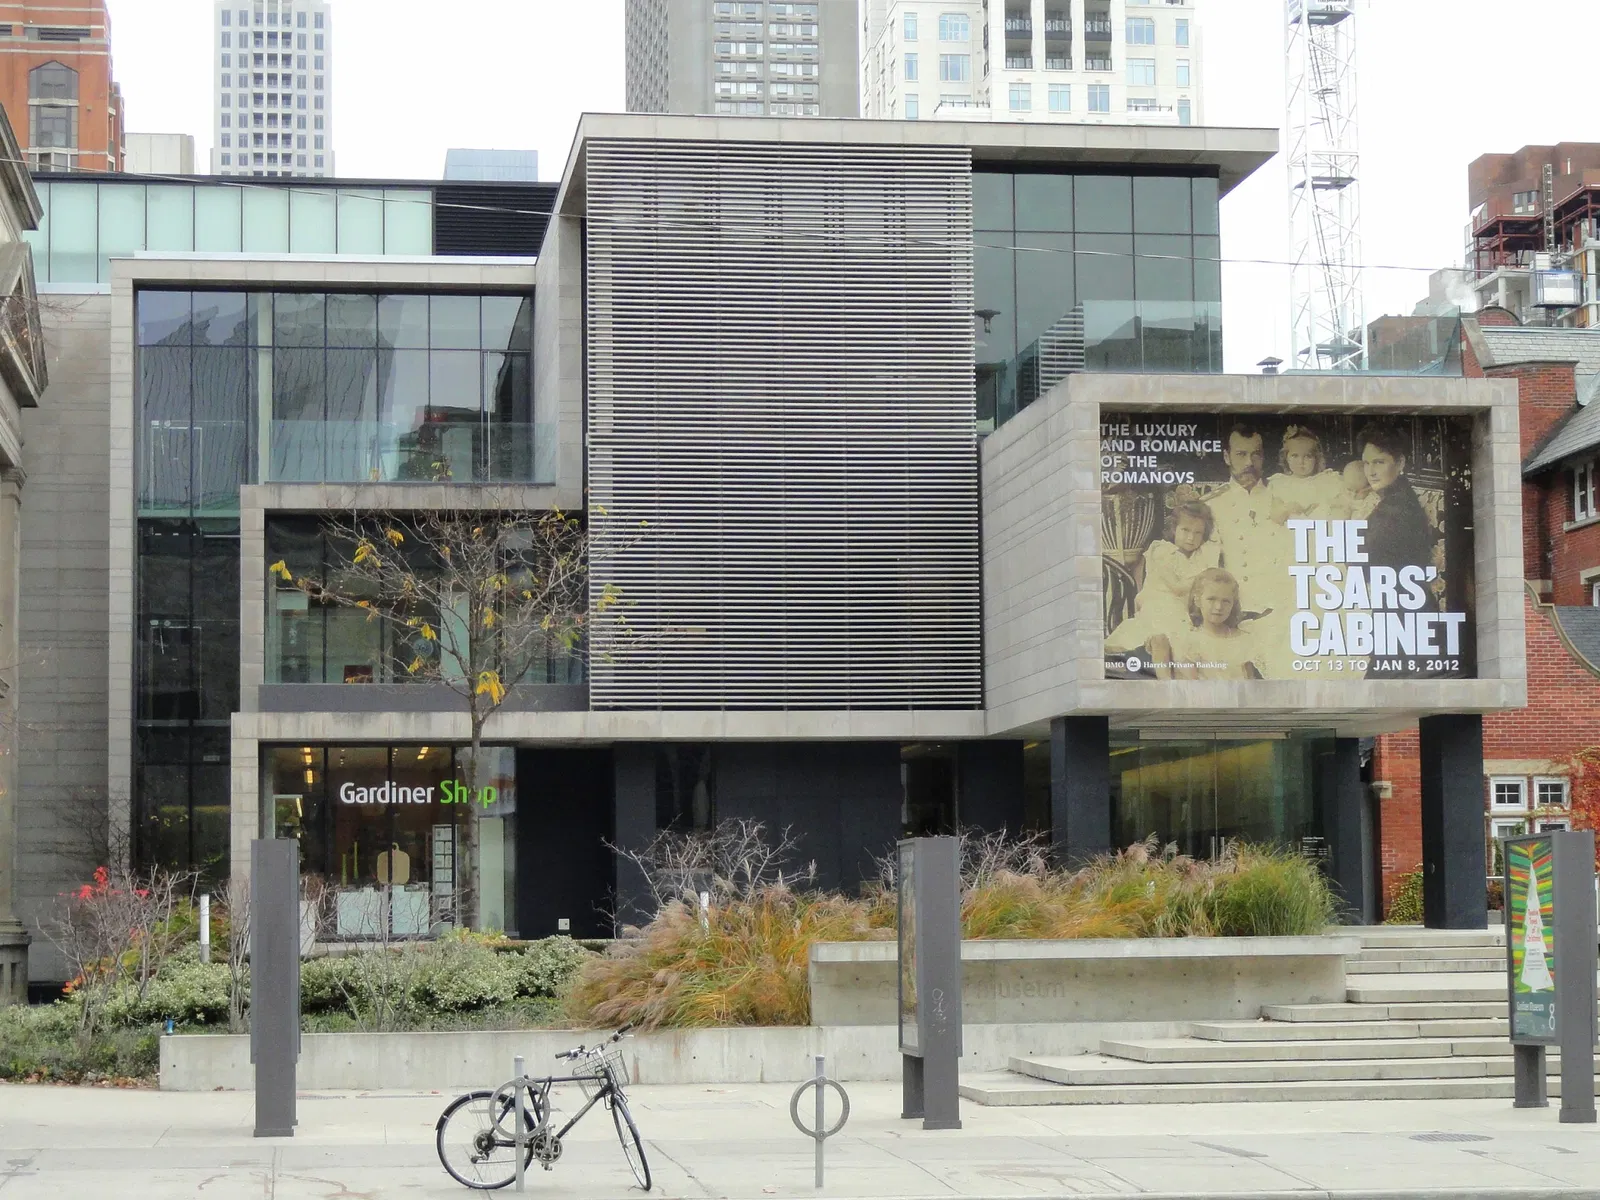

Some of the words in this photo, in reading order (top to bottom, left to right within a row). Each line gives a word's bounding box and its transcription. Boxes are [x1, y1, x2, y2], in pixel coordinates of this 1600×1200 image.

[1100, 424, 1130, 436] THE
[1135, 424, 1198, 436] LUXURY
[1100, 440, 1135, 452] AND
[1141, 440, 1222, 452] ROMANCE
[1101, 455, 1122, 468] OF
[1127, 455, 1157, 467] THE
[1101, 471, 1195, 483] ROMANOVS
[1287, 519, 1369, 563] THE
[1288, 565, 1437, 610] TSARS'
[1290, 611, 1466, 657] CABINET
[1105, 661, 1124, 669] BMO
[1143, 661, 1167, 669] Harris
[1168, 661, 1195, 669] Private
[1292, 660, 1321, 672] OCT
[1328, 660, 1343, 671] 13
[1349, 660, 1368, 671] TO
[1373, 660, 1402, 671] JAN
[1408, 660, 1420, 673] 8,
[1426, 660, 1459, 671] 2012
[339, 780, 435, 804] Gardiner
